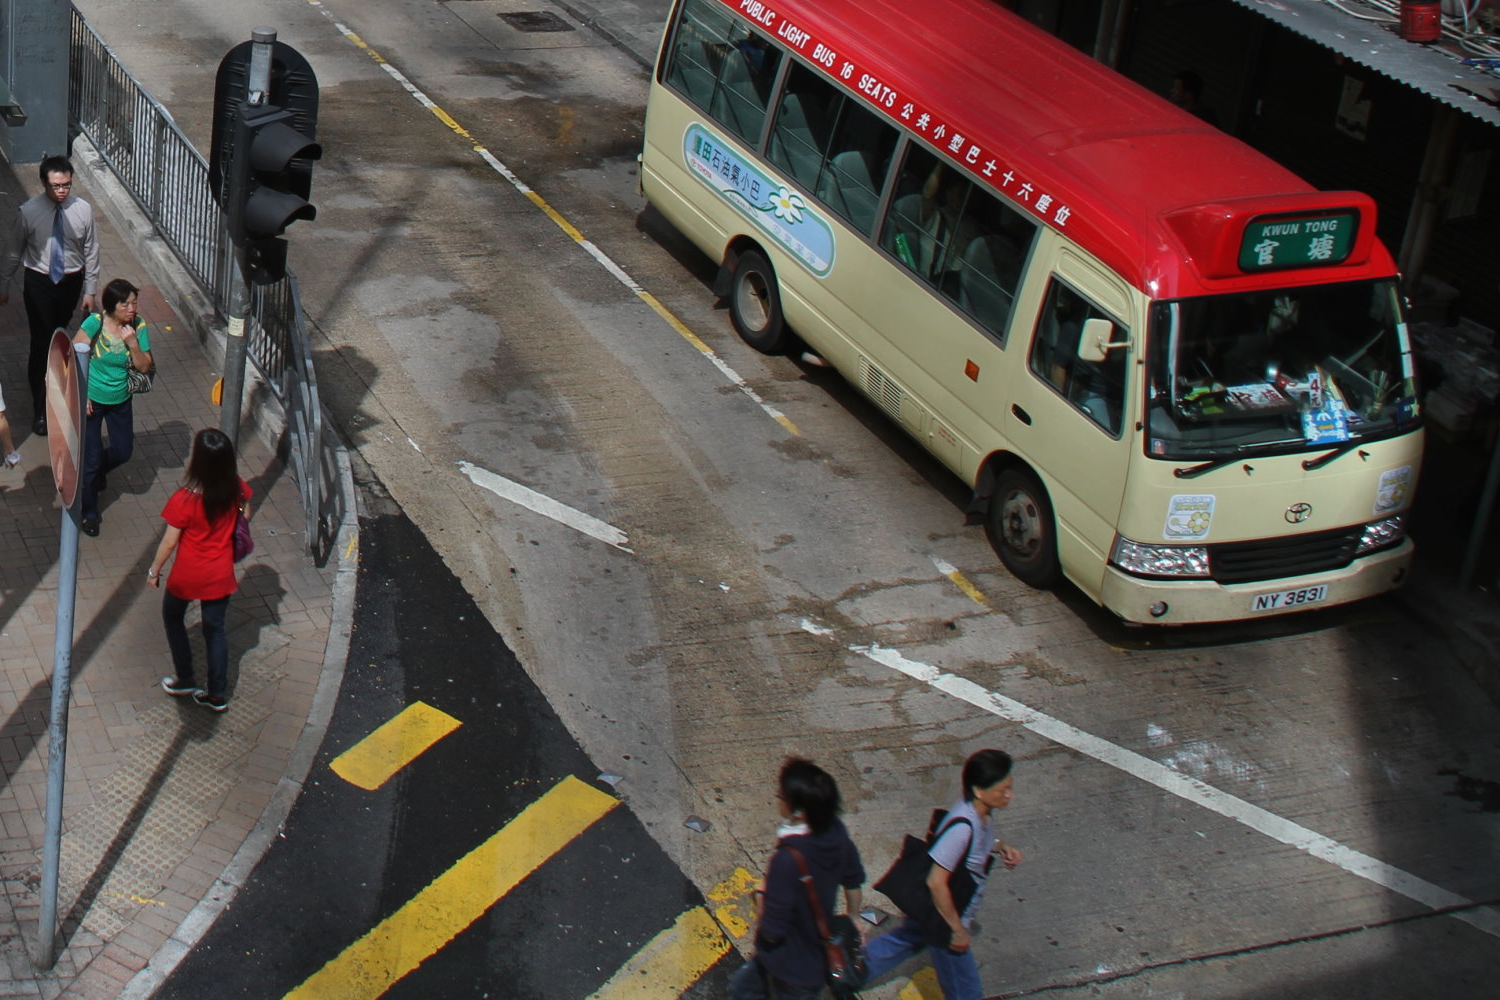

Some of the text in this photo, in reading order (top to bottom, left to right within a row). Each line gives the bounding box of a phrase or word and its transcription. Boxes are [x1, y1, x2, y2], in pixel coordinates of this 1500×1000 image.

[777, 20, 811, 49] LIGHT
[813, 43, 836, 67] BUS
[840, 61, 855, 80] 16
[858, 74, 897, 107] SEATS
[900, 102, 1072, 226] 公共小型巴士十六座位
[1262, 220, 1338, 237] KWUN TONG
[1254, 233, 1335, 266] 官塘
[1256, 587, 1325, 610] NY 3831
